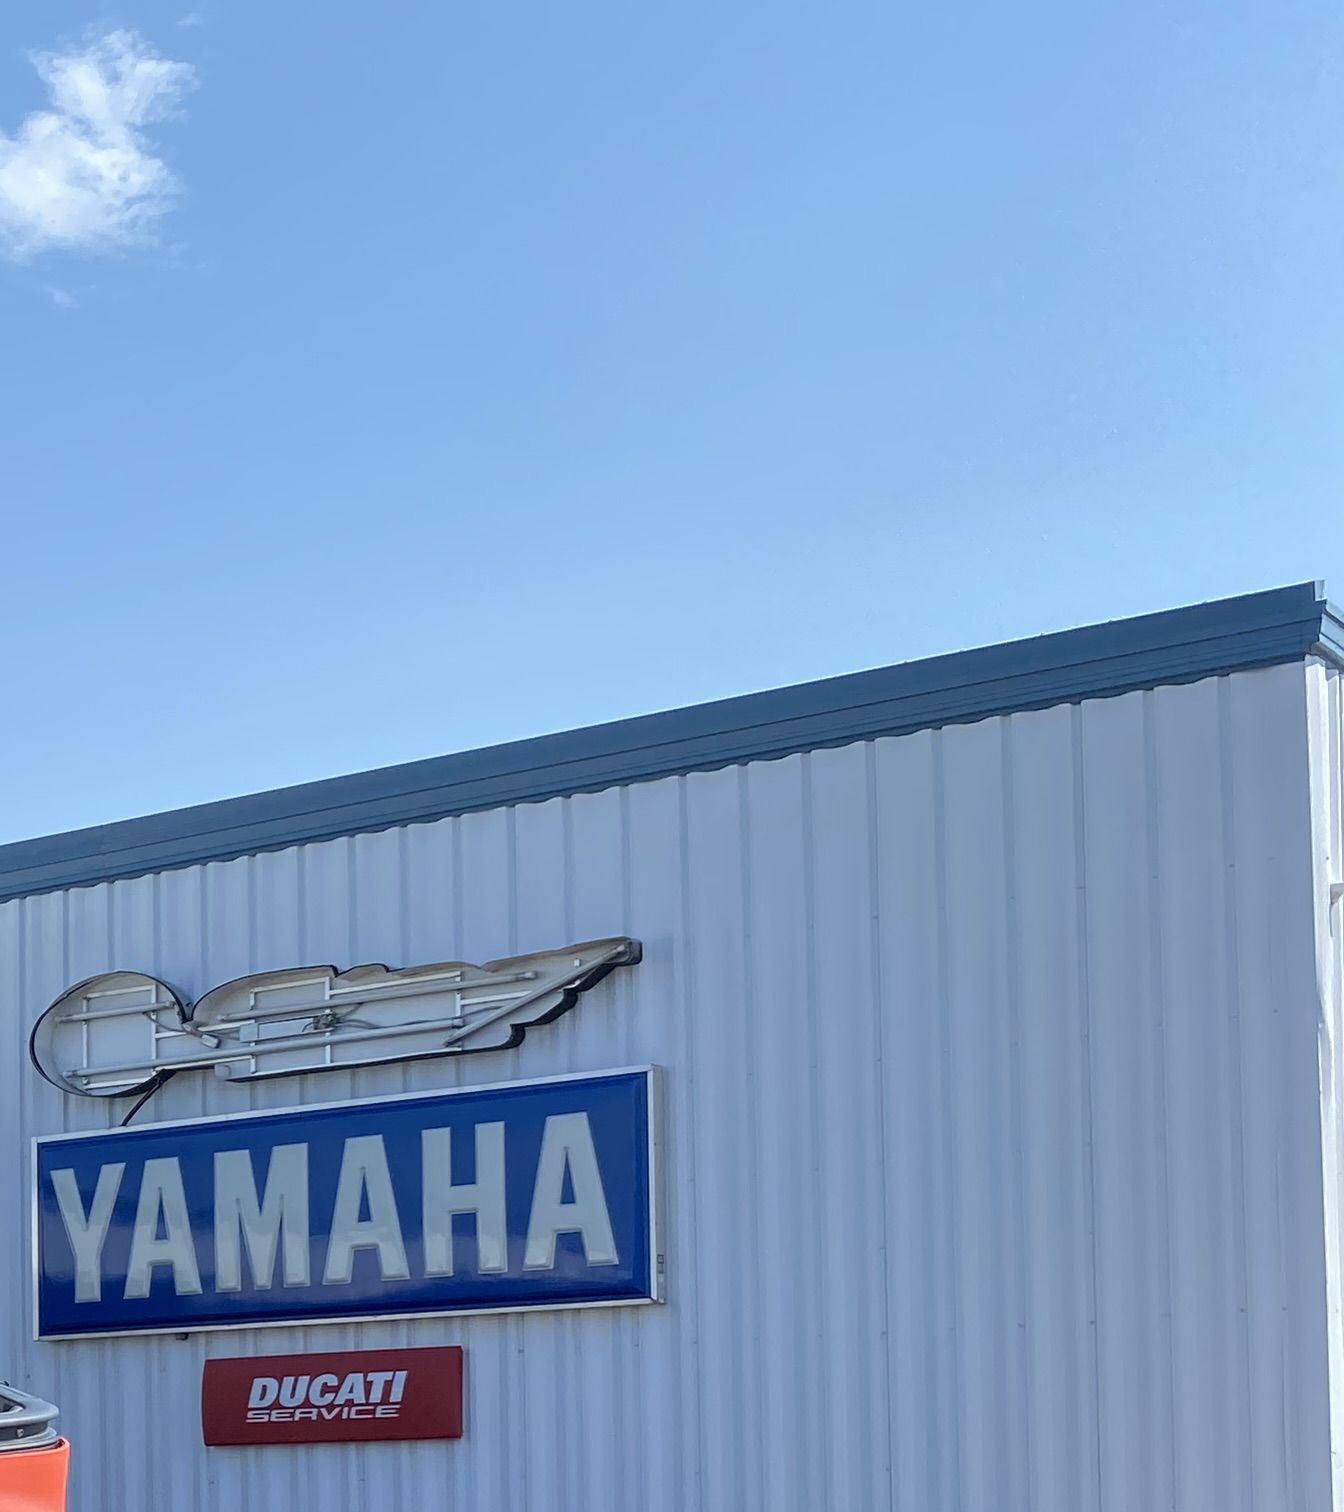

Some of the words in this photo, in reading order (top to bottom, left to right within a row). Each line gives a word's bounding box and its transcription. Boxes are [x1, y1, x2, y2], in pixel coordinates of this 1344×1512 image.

[49, 1111, 620, 1303] YAMAHA
[248, 1370, 408, 1408] DUCATI
[245, 1404, 401, 1423] SERVICE
